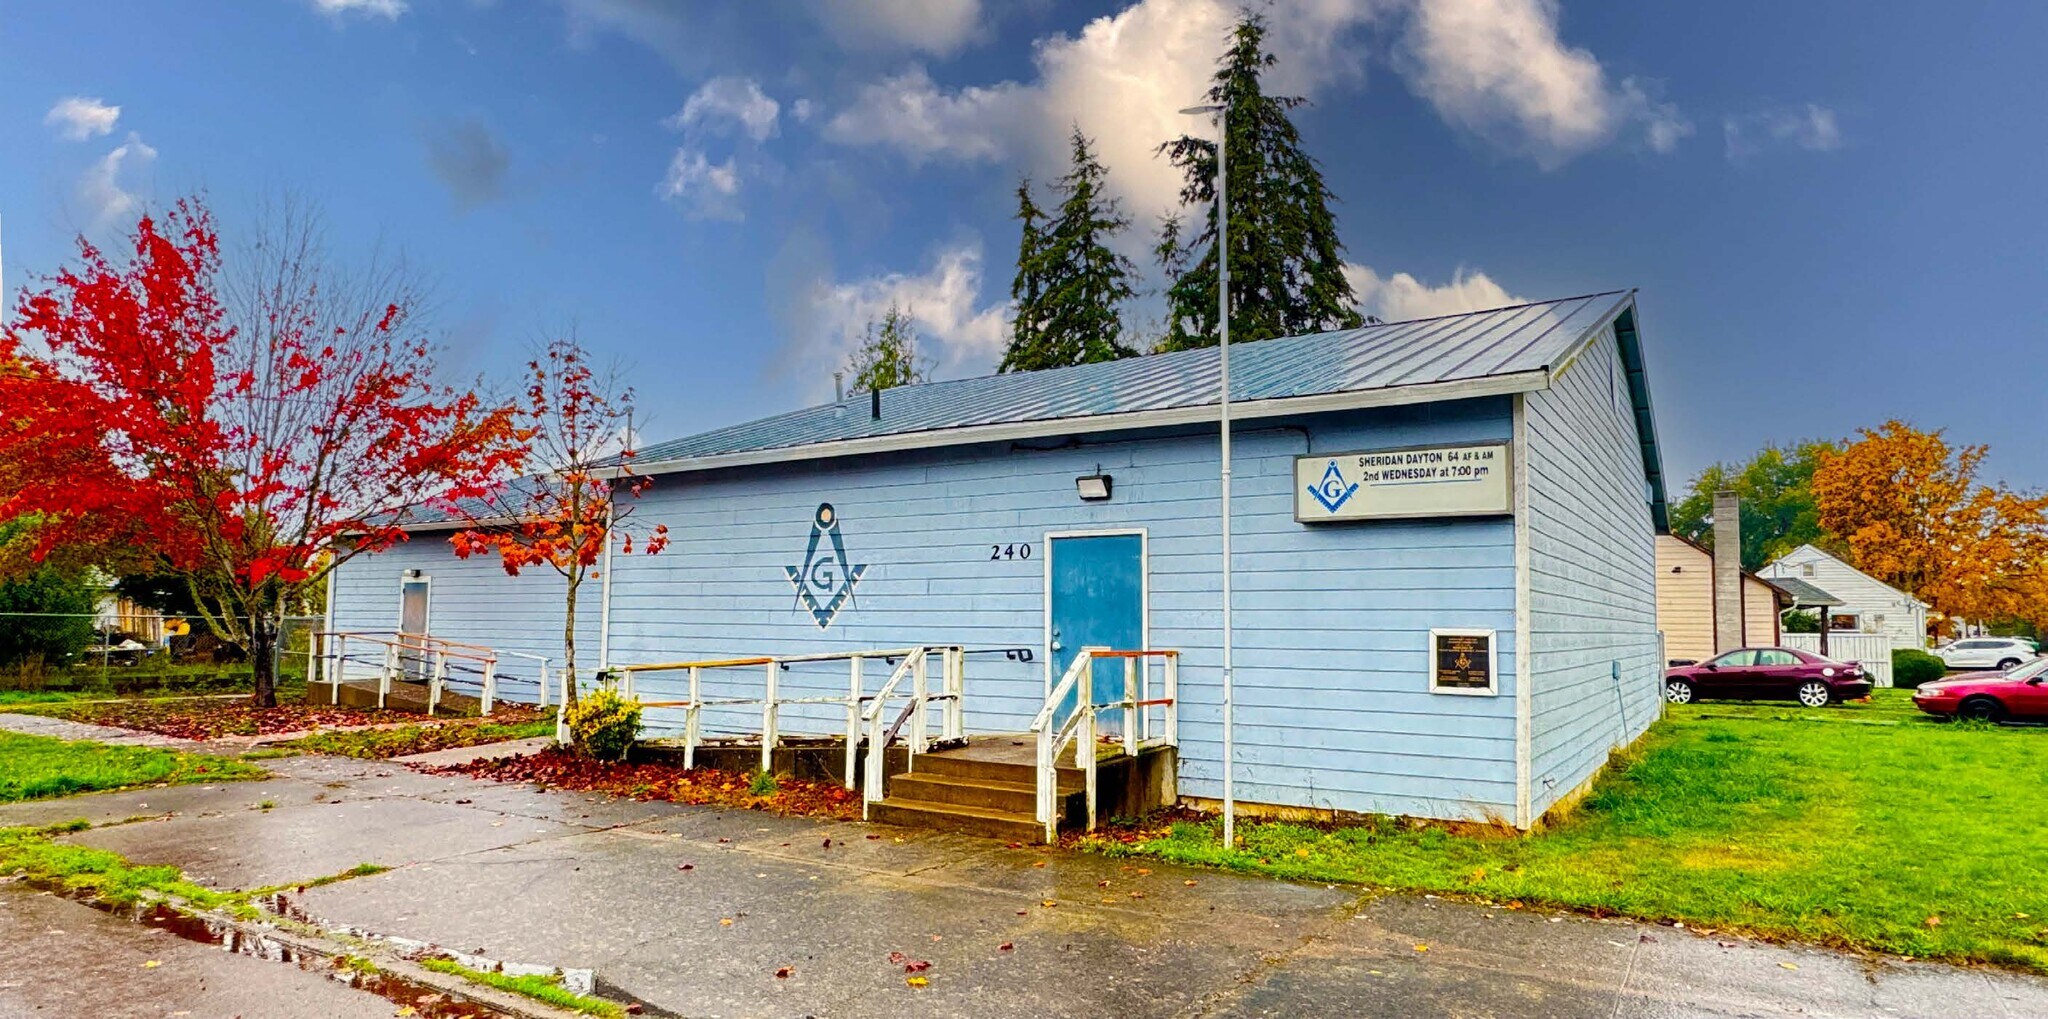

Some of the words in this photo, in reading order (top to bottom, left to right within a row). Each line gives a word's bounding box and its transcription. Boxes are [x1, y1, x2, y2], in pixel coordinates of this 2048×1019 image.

[1359, 455, 1403, 467] SHERIDAN
[1406, 452, 1442, 465] DAYTON
[1448, 451, 1459, 461] 64
[1462, 452, 1473, 461] AF
[1474, 451, 1480, 460] &
[1482, 451, 1494, 460] AM
[1363, 471, 1379, 482] 2nd
[1381, 468, 1437, 480] WEDNESDAY
[1439, 467, 1449, 477] at
[1451, 466, 1472, 476] 7:00
[1474, 467, 1488, 478] pm
[1324, 480, 1342, 498] G
[990, 543, 1031, 561] 240
[811, 556, 834, 593] G
